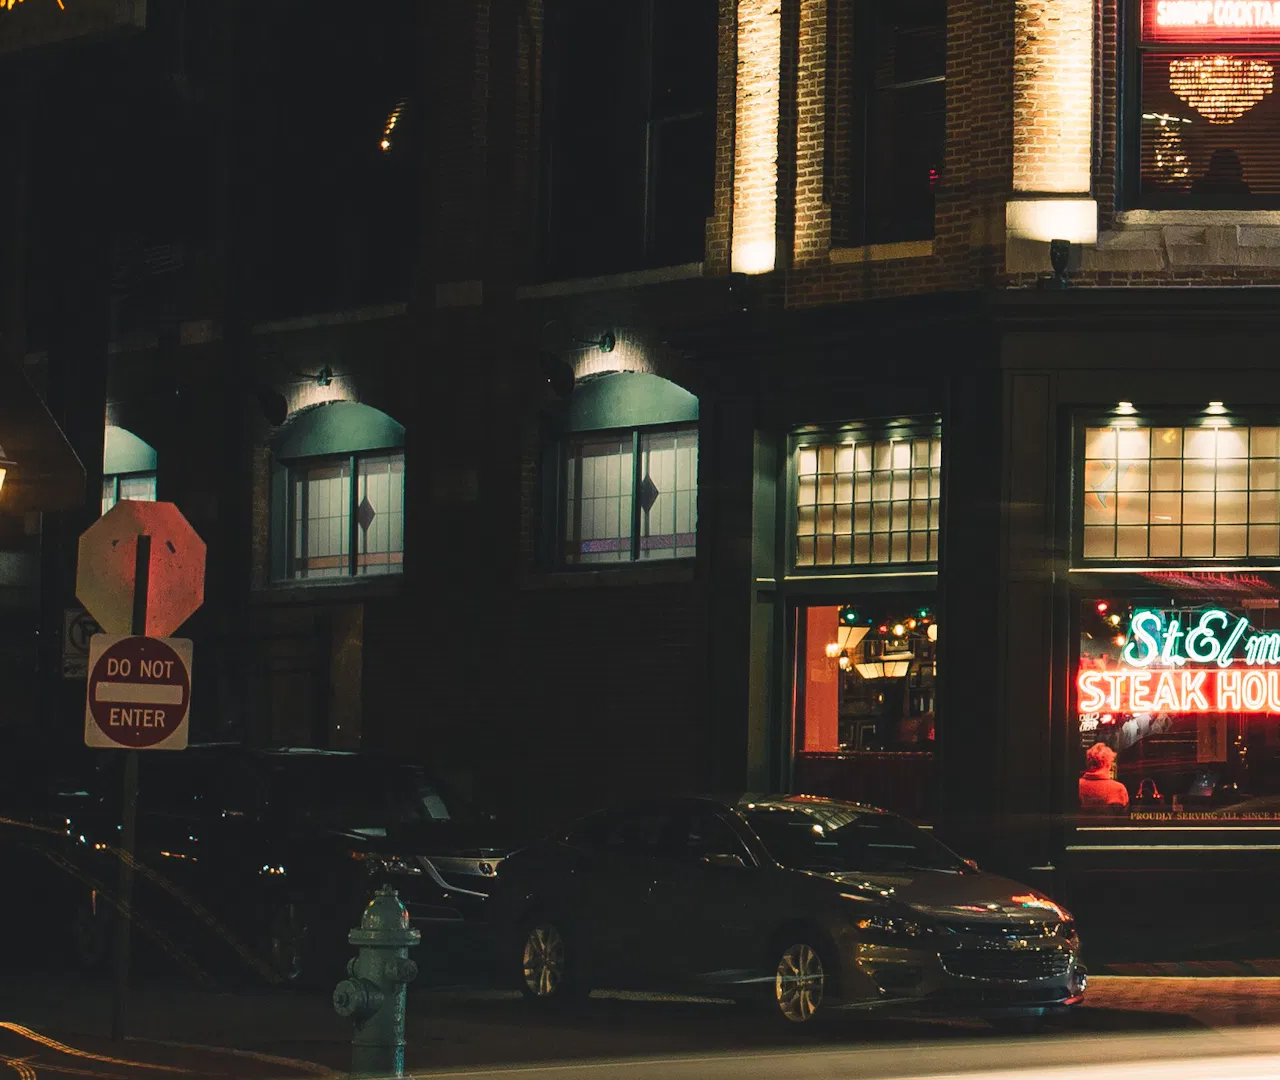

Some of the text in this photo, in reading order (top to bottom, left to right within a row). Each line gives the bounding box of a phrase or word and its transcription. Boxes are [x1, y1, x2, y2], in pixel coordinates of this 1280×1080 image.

[107, 658, 131, 677] DO
[140, 660, 174, 678] NOT
[1079, 670, 1209, 712] STEAK
[110, 708, 166, 728] ENTER
[1130, 812, 1172, 821] PROUDLY
[1176, 812, 1218, 821] SERVING
[1221, 812, 1238, 820] ALL
[1242, 812, 1270, 820] SINCE
